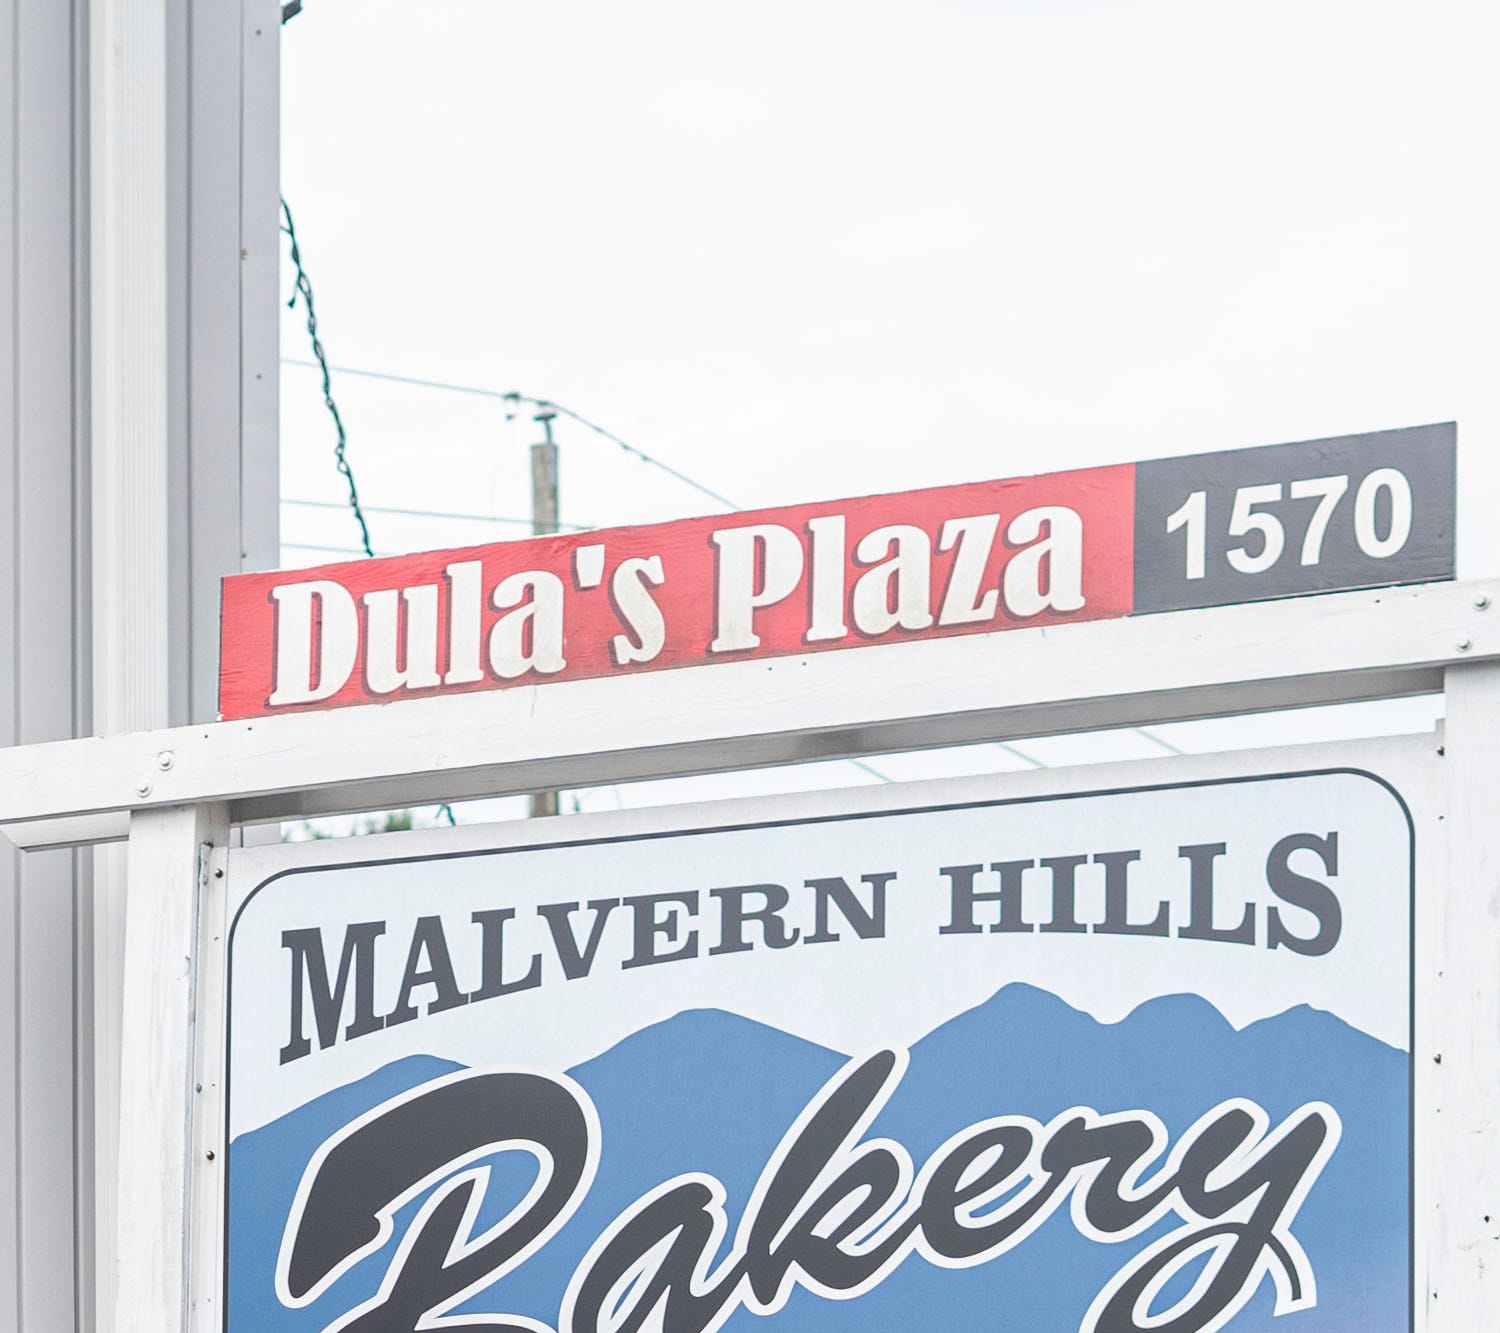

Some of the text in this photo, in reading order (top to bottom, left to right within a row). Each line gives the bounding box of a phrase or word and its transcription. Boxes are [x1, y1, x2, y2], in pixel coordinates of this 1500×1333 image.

[267, 467, 1413, 708] Dula's Plaza 1570
[279, 830, 1342, 1066] MALVERN HILLS
